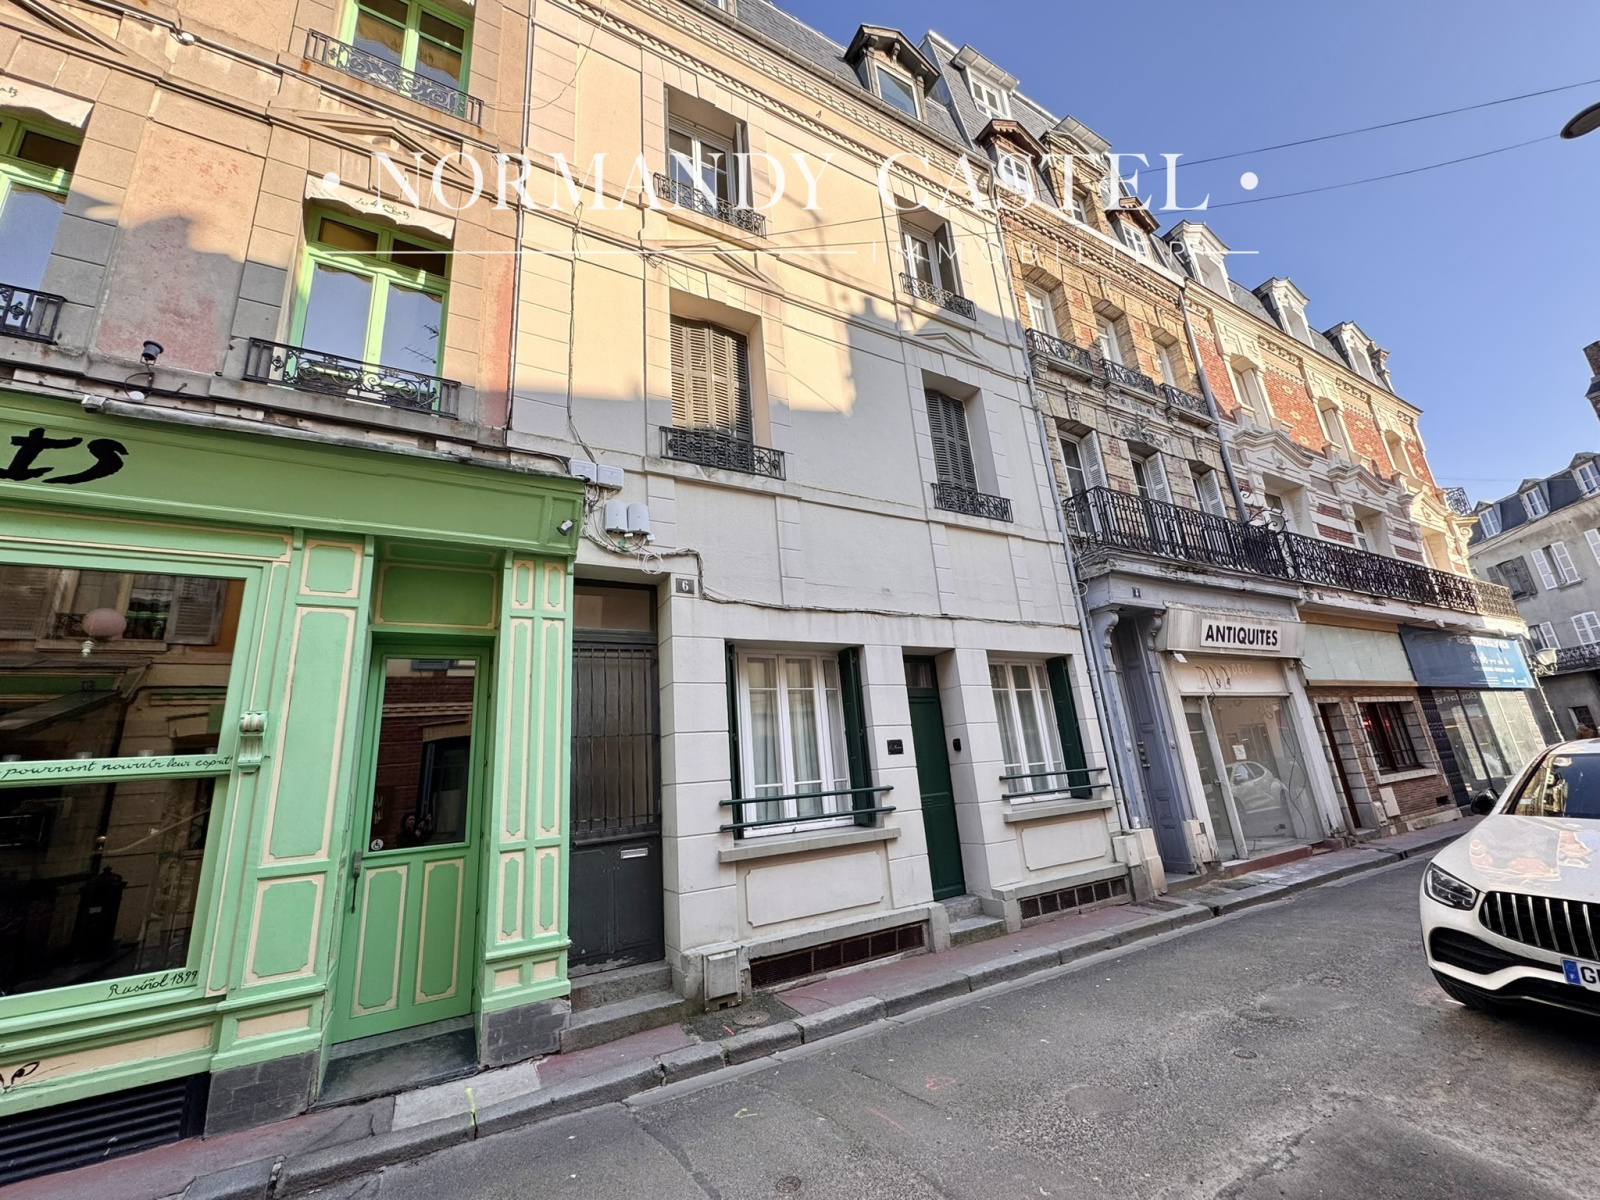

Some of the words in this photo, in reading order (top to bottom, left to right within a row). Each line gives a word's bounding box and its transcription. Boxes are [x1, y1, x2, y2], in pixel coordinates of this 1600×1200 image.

[682, 580, 689, 591] 6
[1205, 624, 1278, 647] ANTIQUITES
[1, 760, 97, 780] pourront
[166, 757, 191, 768] leur
[170, 970, 198, 986] 1899
